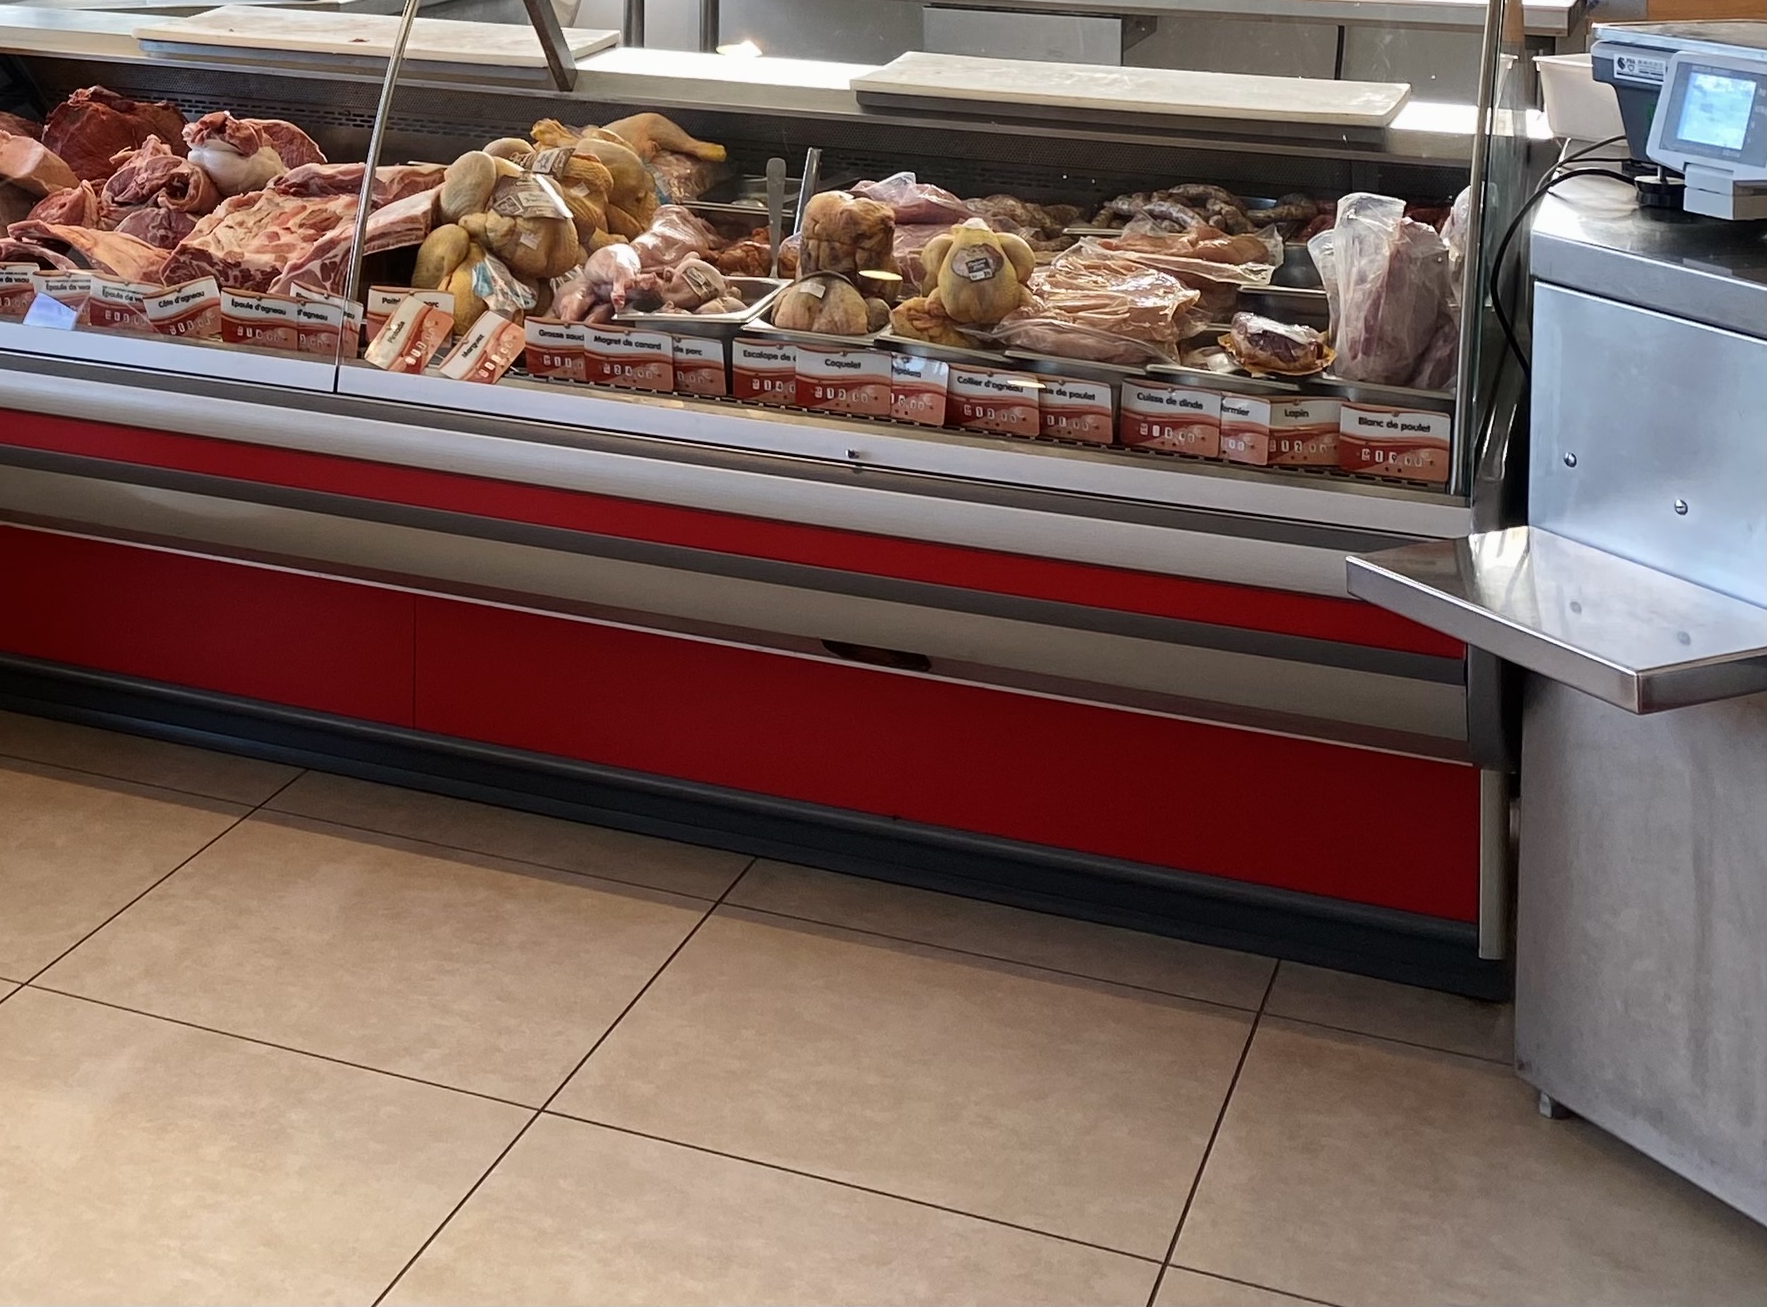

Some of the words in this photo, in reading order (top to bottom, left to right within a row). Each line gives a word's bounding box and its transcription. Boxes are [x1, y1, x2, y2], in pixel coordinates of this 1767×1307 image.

[158, 299, 174, 308] Côte
[174, 291, 205, 304] d'agneau
[255, 303, 287, 316] d'agneau
[538, 329, 565, 340] Grosse
[594, 335, 622, 347] Magret
[623, 339, 633, 347] de
[635, 341, 662, 351] canard
[685, 347, 703, 357] porc
[743, 349, 778, 362] Escalope
[780, 352, 791, 361] de
[824, 358, 862, 370] Coquelet
[957, 376, 983, 387] Collier
[1056, 387, 1067, 396] de
[1068, 390, 1096, 401] poulet
[1137, 392, 1164, 404] Cuisse
[1165, 396, 1177, 406] de
[1179, 398, 1203, 410] dinde
[1284, 409, 1309, 419] Lapin
[1358, 417, 1384, 428] Blanc
[1386, 419, 1399, 429] de
[1400, 421, 1431, 433] poulet
